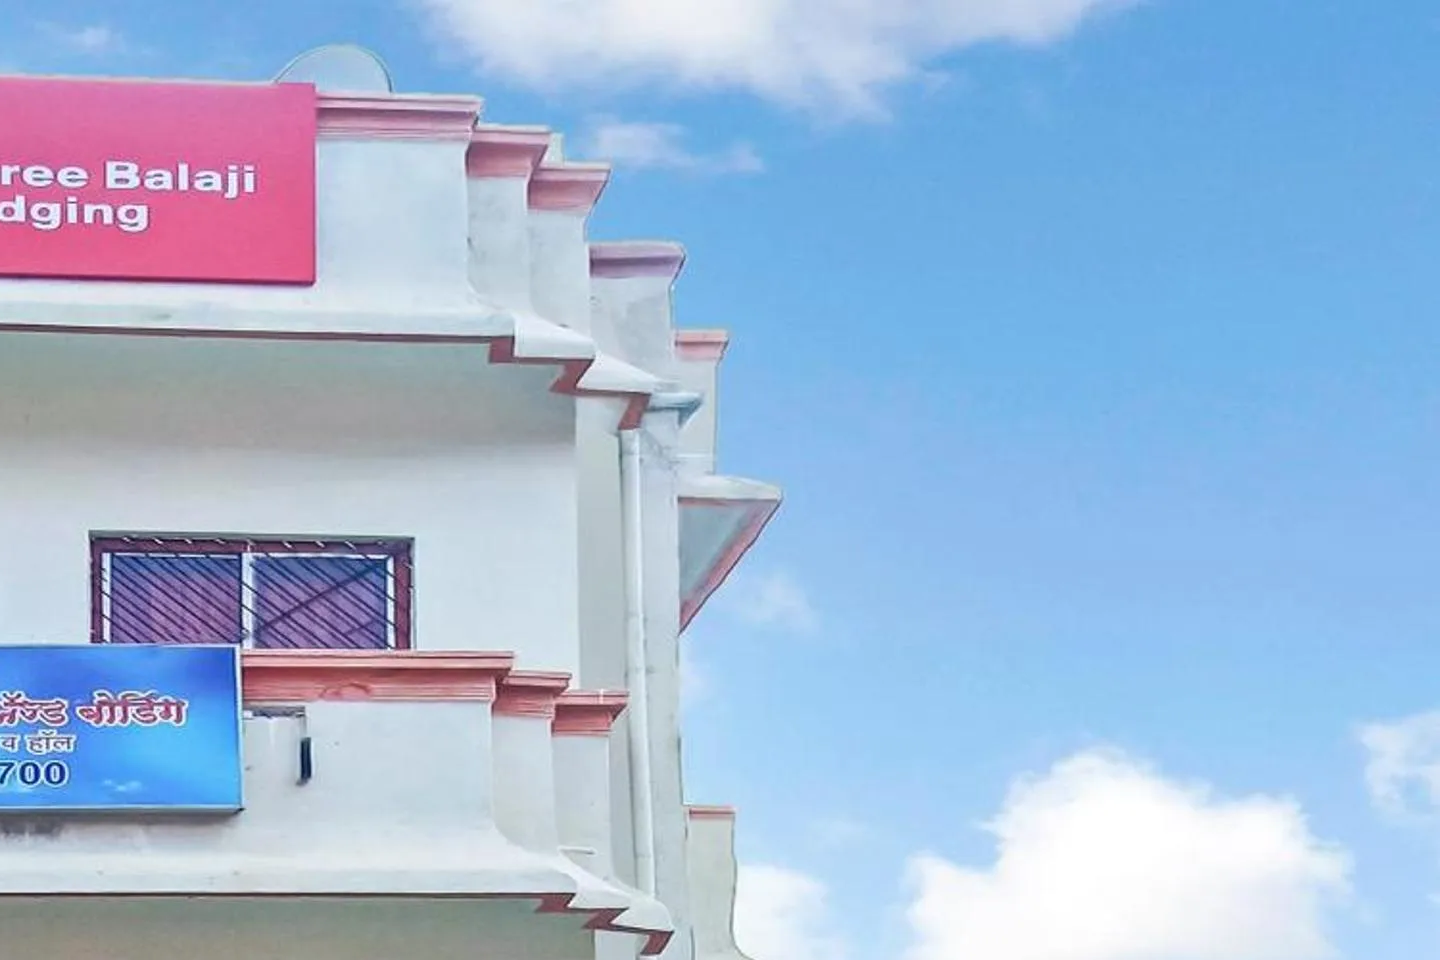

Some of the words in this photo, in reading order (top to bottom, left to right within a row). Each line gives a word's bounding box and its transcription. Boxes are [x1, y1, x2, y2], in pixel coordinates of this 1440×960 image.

[106, 160, 257, 199] Balaji
[0, 735, 19, 751] व
[25, 730, 76, 753] हॉल
